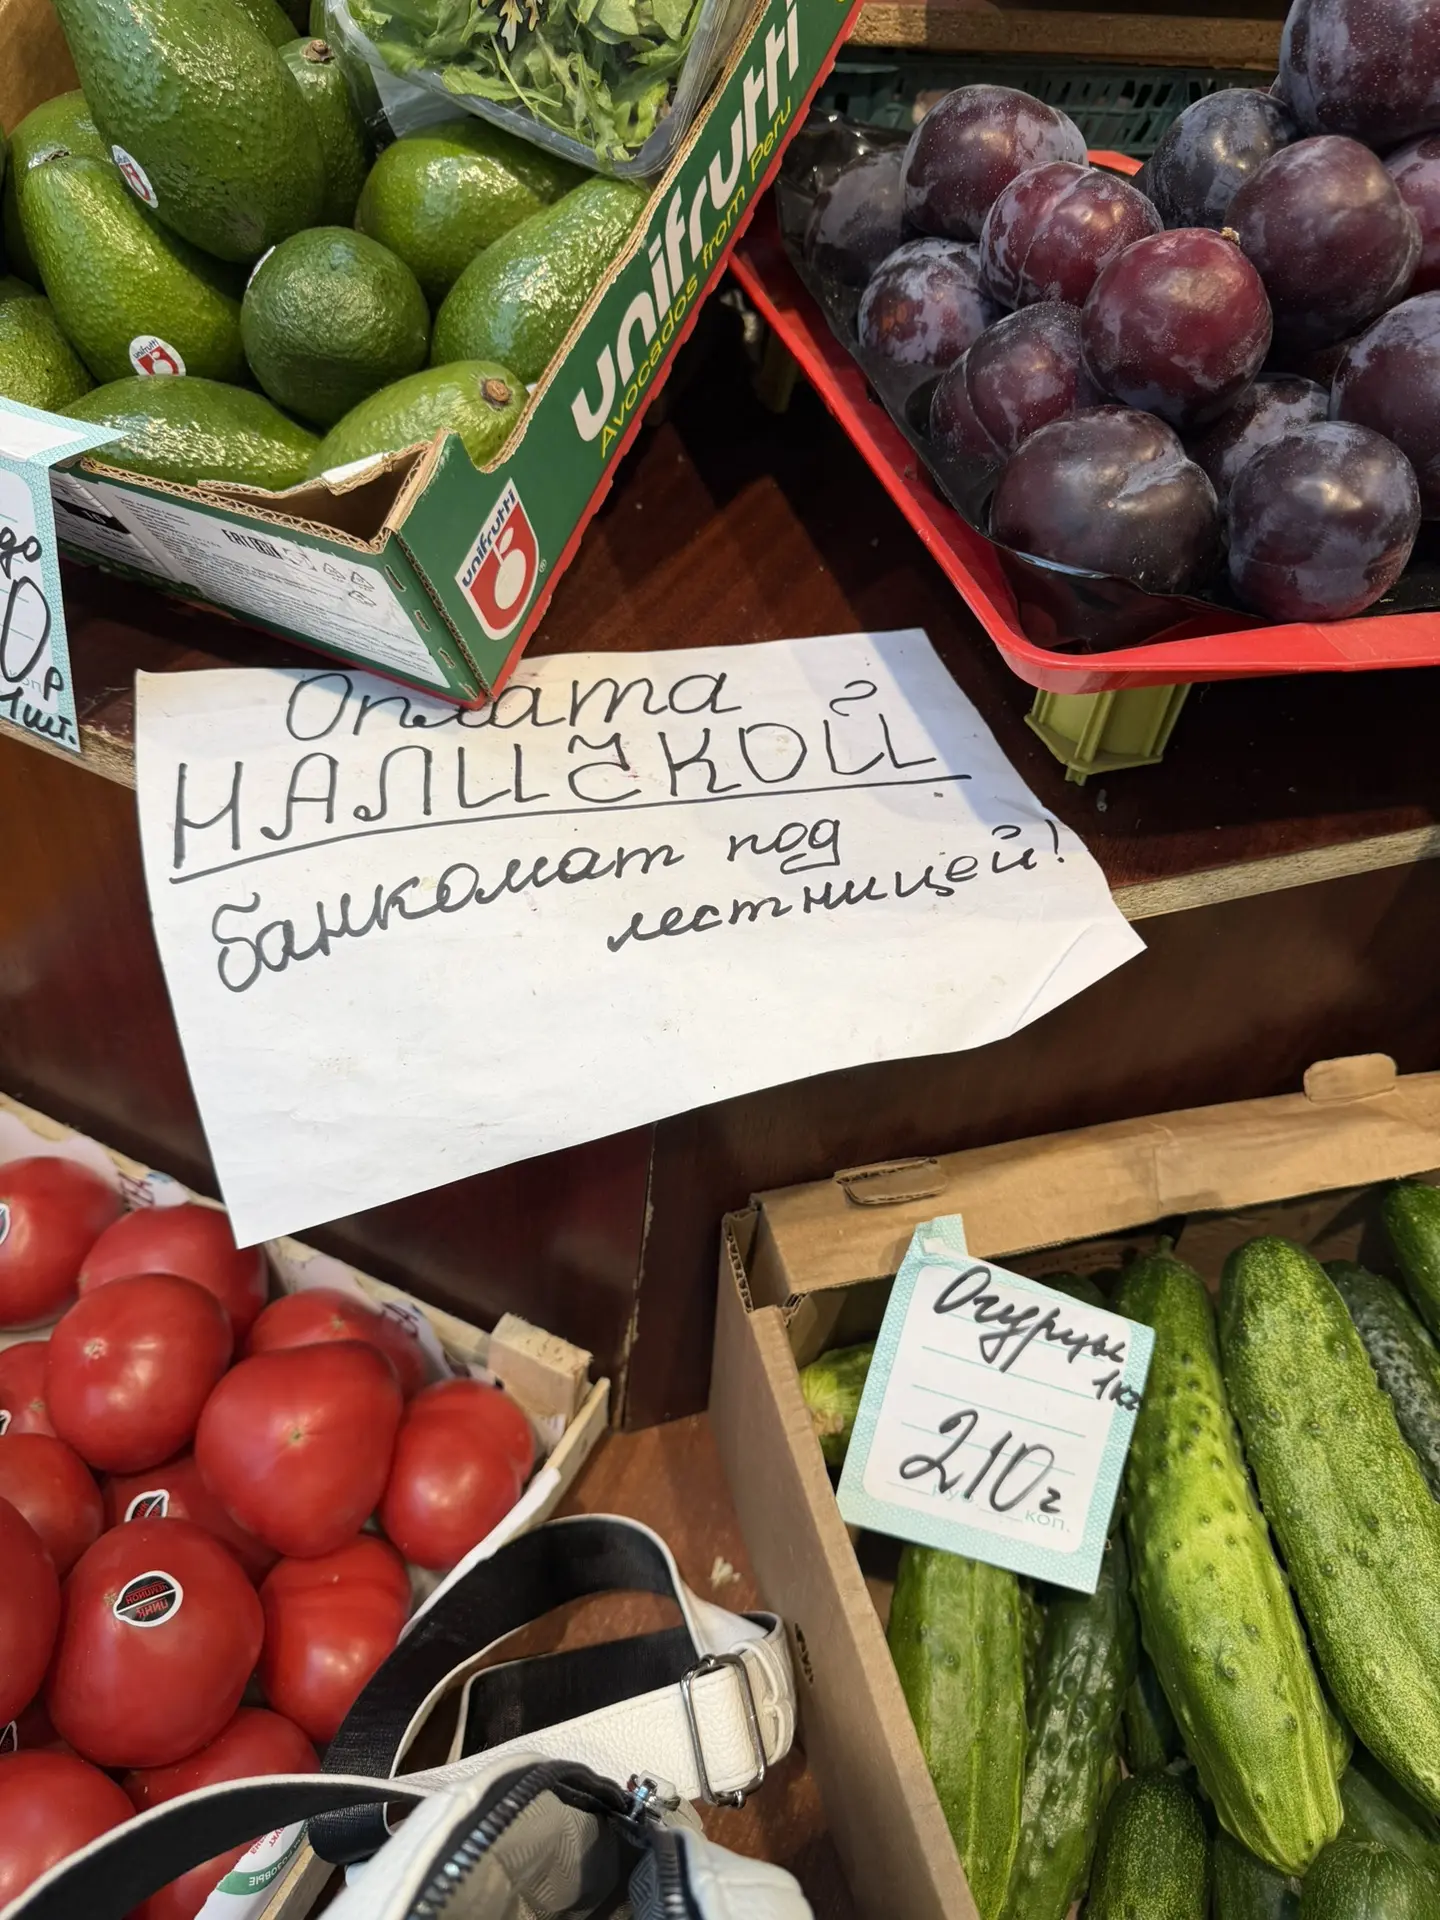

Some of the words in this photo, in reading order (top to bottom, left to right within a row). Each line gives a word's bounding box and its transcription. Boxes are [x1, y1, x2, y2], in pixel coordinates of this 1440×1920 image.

[570, 0, 799, 442] unifrutti
[599, 272, 698, 458] Avocados
[702, 186, 746, 273] from
[750, 96, 791, 182] Peru
[133, 339, 158, 359] unifrutti
[462, 489, 516, 587] unifrutti
[173, 680, 937, 869] НАЛИЧКОЙ
[607, 818, 1065, 952] лестницей!
[728, 818, 841, 875] под
[933, 1265, 1126, 1373] Огурцы
[1025, 1509, 1070, 1533] коп.
[136, 1599, 169, 1619] ПИНК
